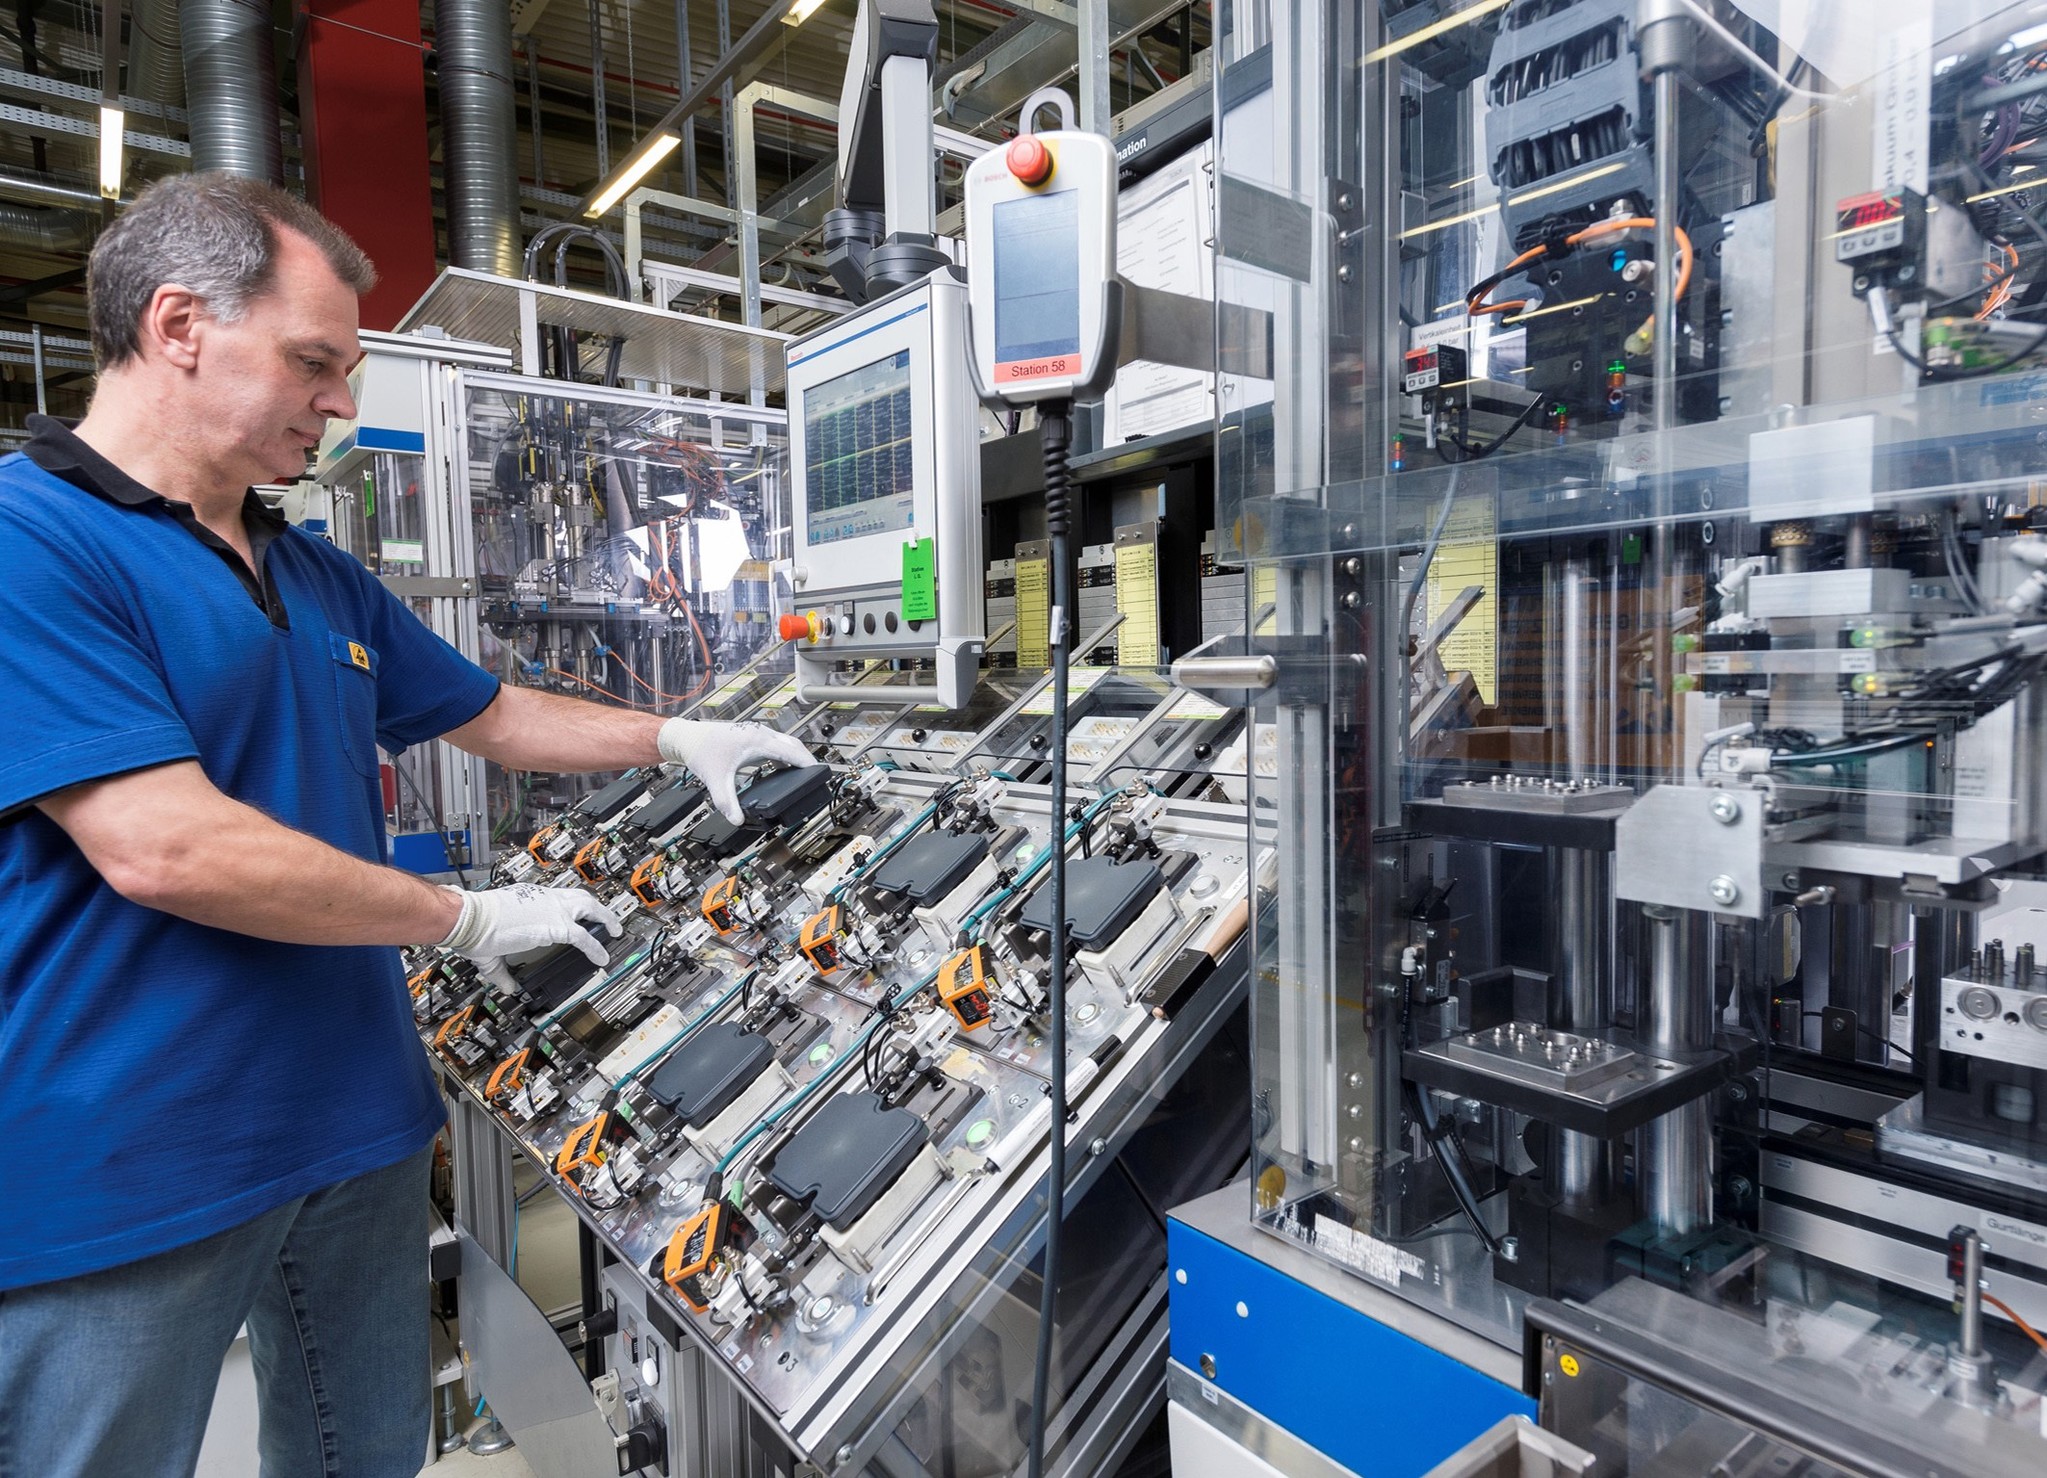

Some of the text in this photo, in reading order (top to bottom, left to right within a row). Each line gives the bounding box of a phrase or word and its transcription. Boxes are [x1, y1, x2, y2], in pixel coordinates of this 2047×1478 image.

[1011, 359, 1066, 377] Station 58
[1017, 1097, 1029, 1109] 2
[785, 1358, 799, 1373] 3
